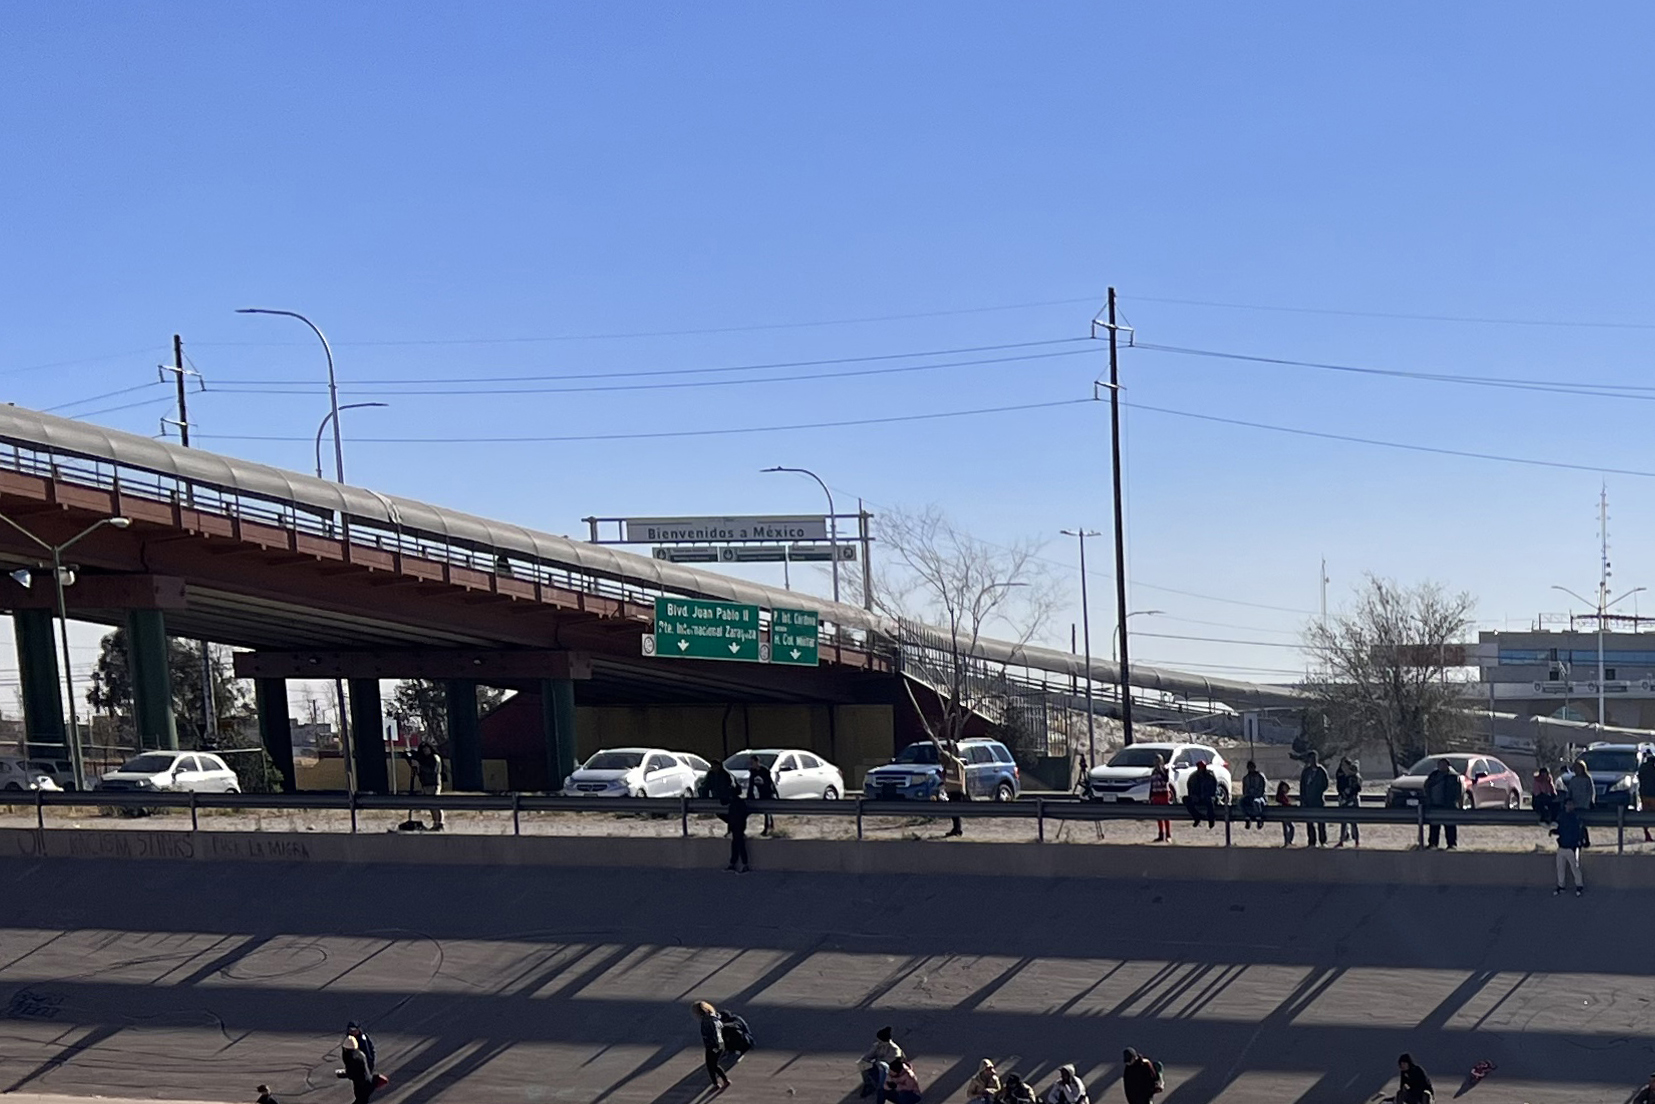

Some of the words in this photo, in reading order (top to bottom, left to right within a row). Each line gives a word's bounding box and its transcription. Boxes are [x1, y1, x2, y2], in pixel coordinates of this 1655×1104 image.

[647, 527, 734, 540] Bienvenidos
[739, 529, 748, 539] a
[753, 524, 805, 539] México
[692, 605, 713, 620] Juan
[716, 607, 740, 622] Pablo
[742, 609, 750, 622] II
